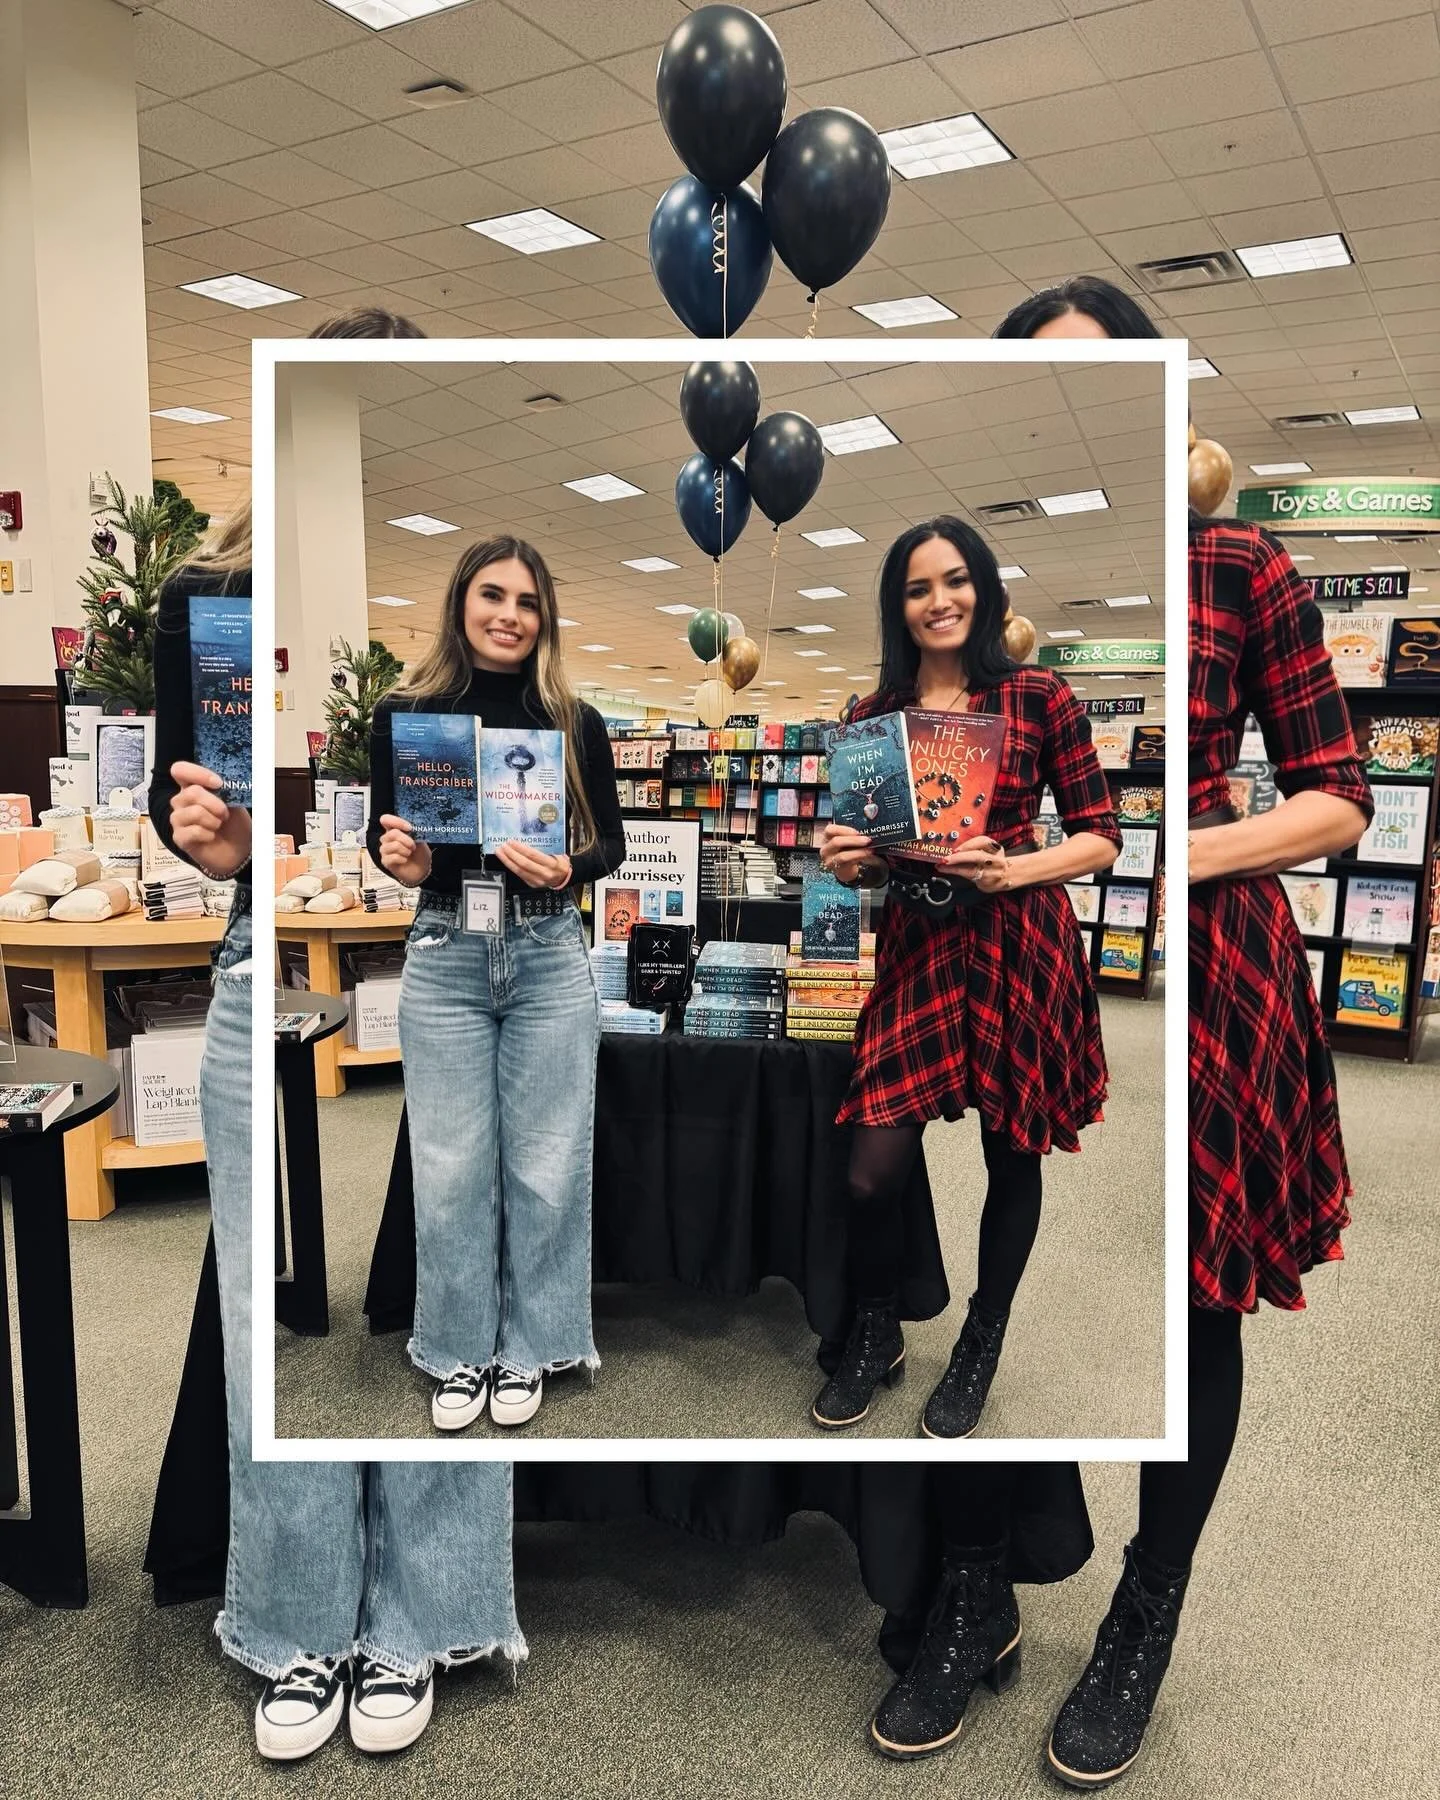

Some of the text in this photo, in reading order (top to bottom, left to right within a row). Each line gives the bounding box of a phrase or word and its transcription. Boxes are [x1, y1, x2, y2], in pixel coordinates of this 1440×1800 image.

[1267, 486, 1433, 519] Toys & Games
[1340, 618, 1370, 631] HUMBLE
[1372, 617, 1384, 631] PIE
[1056, 644, 1160, 665] Toys & Games
[201, 700, 252, 715] TRAN
[1374, 717, 1422, 729] BUFFALO
[933, 725, 966, 742] THE
[1371, 726, 1424, 739] FLUFFALO
[847, 748, 883, 764] WHEN
[417, 762, 455, 774] HELLO,
[857, 764, 875, 776] I'M
[916, 758, 968, 777] ONES
[399, 776, 474, 788] TRANSCRIBER
[851, 776, 884, 790] DEAD
[485, 791, 561, 801] WIDOWMAKER
[435, 826, 474, 834] MORRISSEY
[870, 821, 909, 833] MORRISSEY
[625, 831, 670, 844] Author
[1372, 832, 1409, 850] FISH
[920, 844, 953, 855] MORRIS
[626, 851, 677, 863] annah
[1122, 859, 1145, 869] FISH
[608, 869, 685, 885] Morrissey
[818, 911, 843, 919] DEAD
[143, 1085, 196, 1099] Weighted
[146, 1099, 168, 1110] Lap
